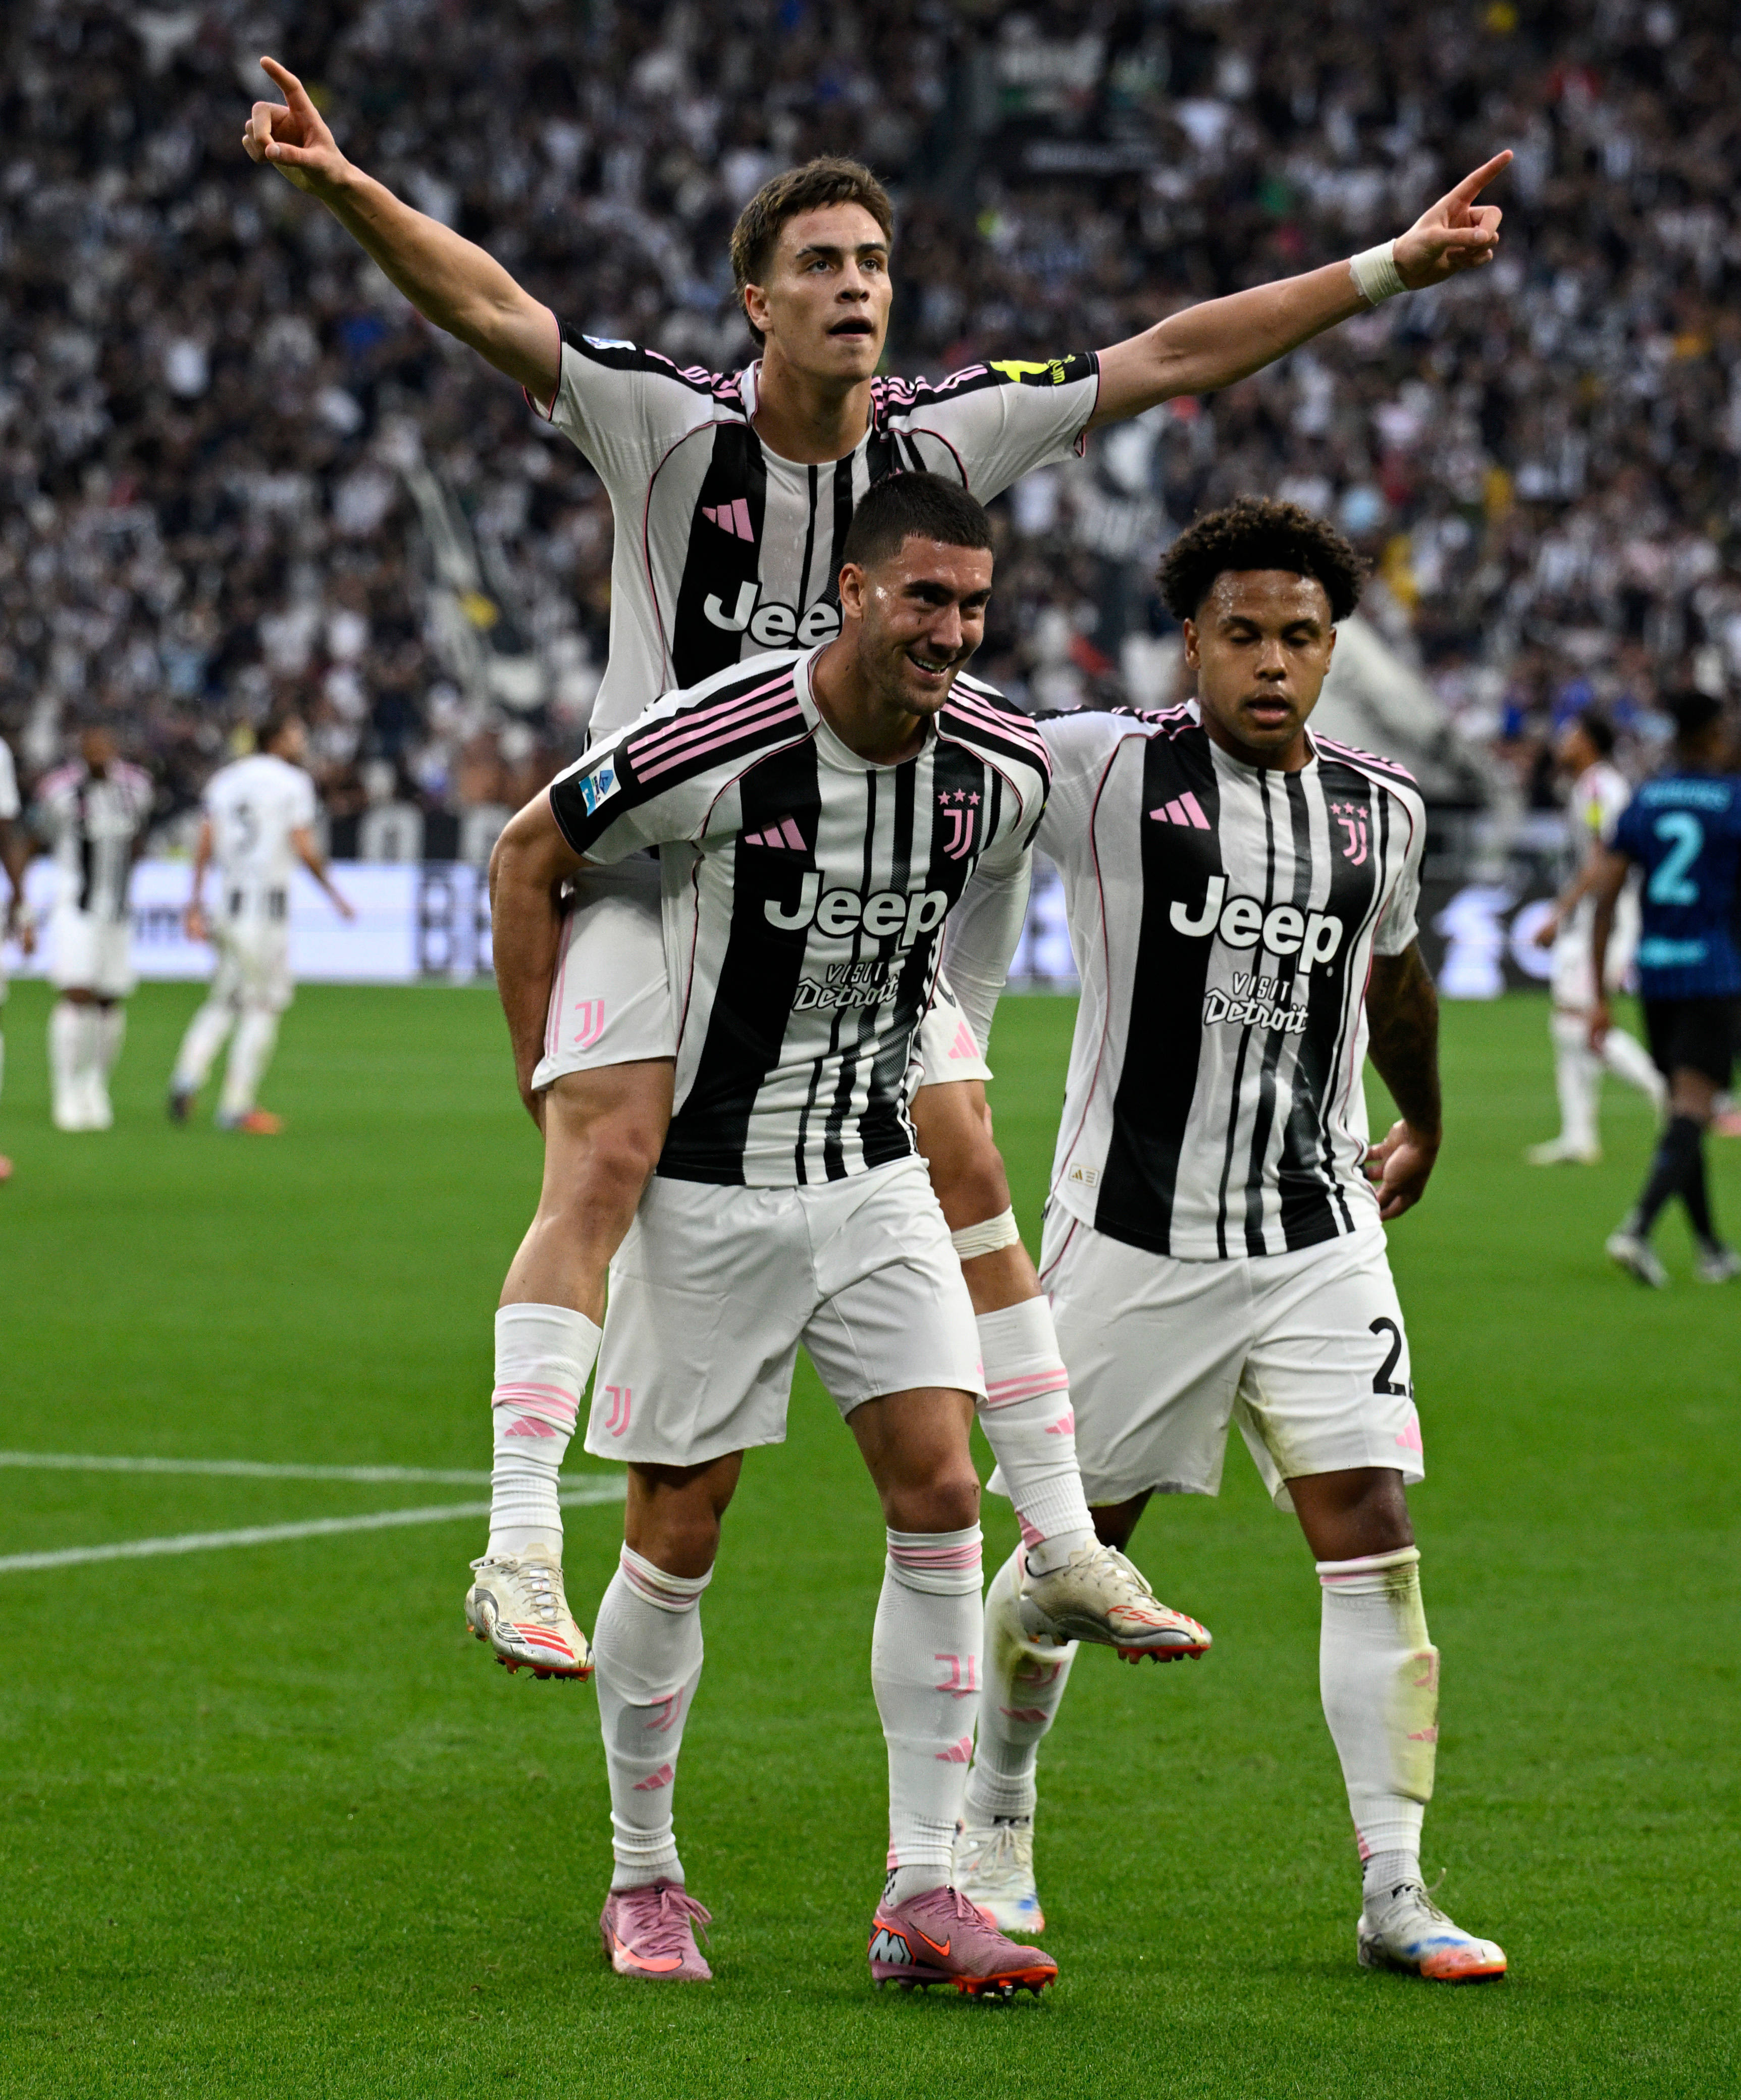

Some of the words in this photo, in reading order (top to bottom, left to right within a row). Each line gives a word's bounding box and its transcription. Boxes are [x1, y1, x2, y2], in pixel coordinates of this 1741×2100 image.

[704, 581, 839, 647] Jee
[1648, 811, 1705, 906] 2
[764, 872, 948, 947] Jeep
[1169, 875, 1344, 973] Jeep
[793, 975, 899, 1011] Detroit
[827, 962, 884, 983] VISIT
[1233, 972, 1290, 1002] VISIT
[1205, 988, 1309, 1034] Detroit
[1368, 1317, 1413, 1402] 2
